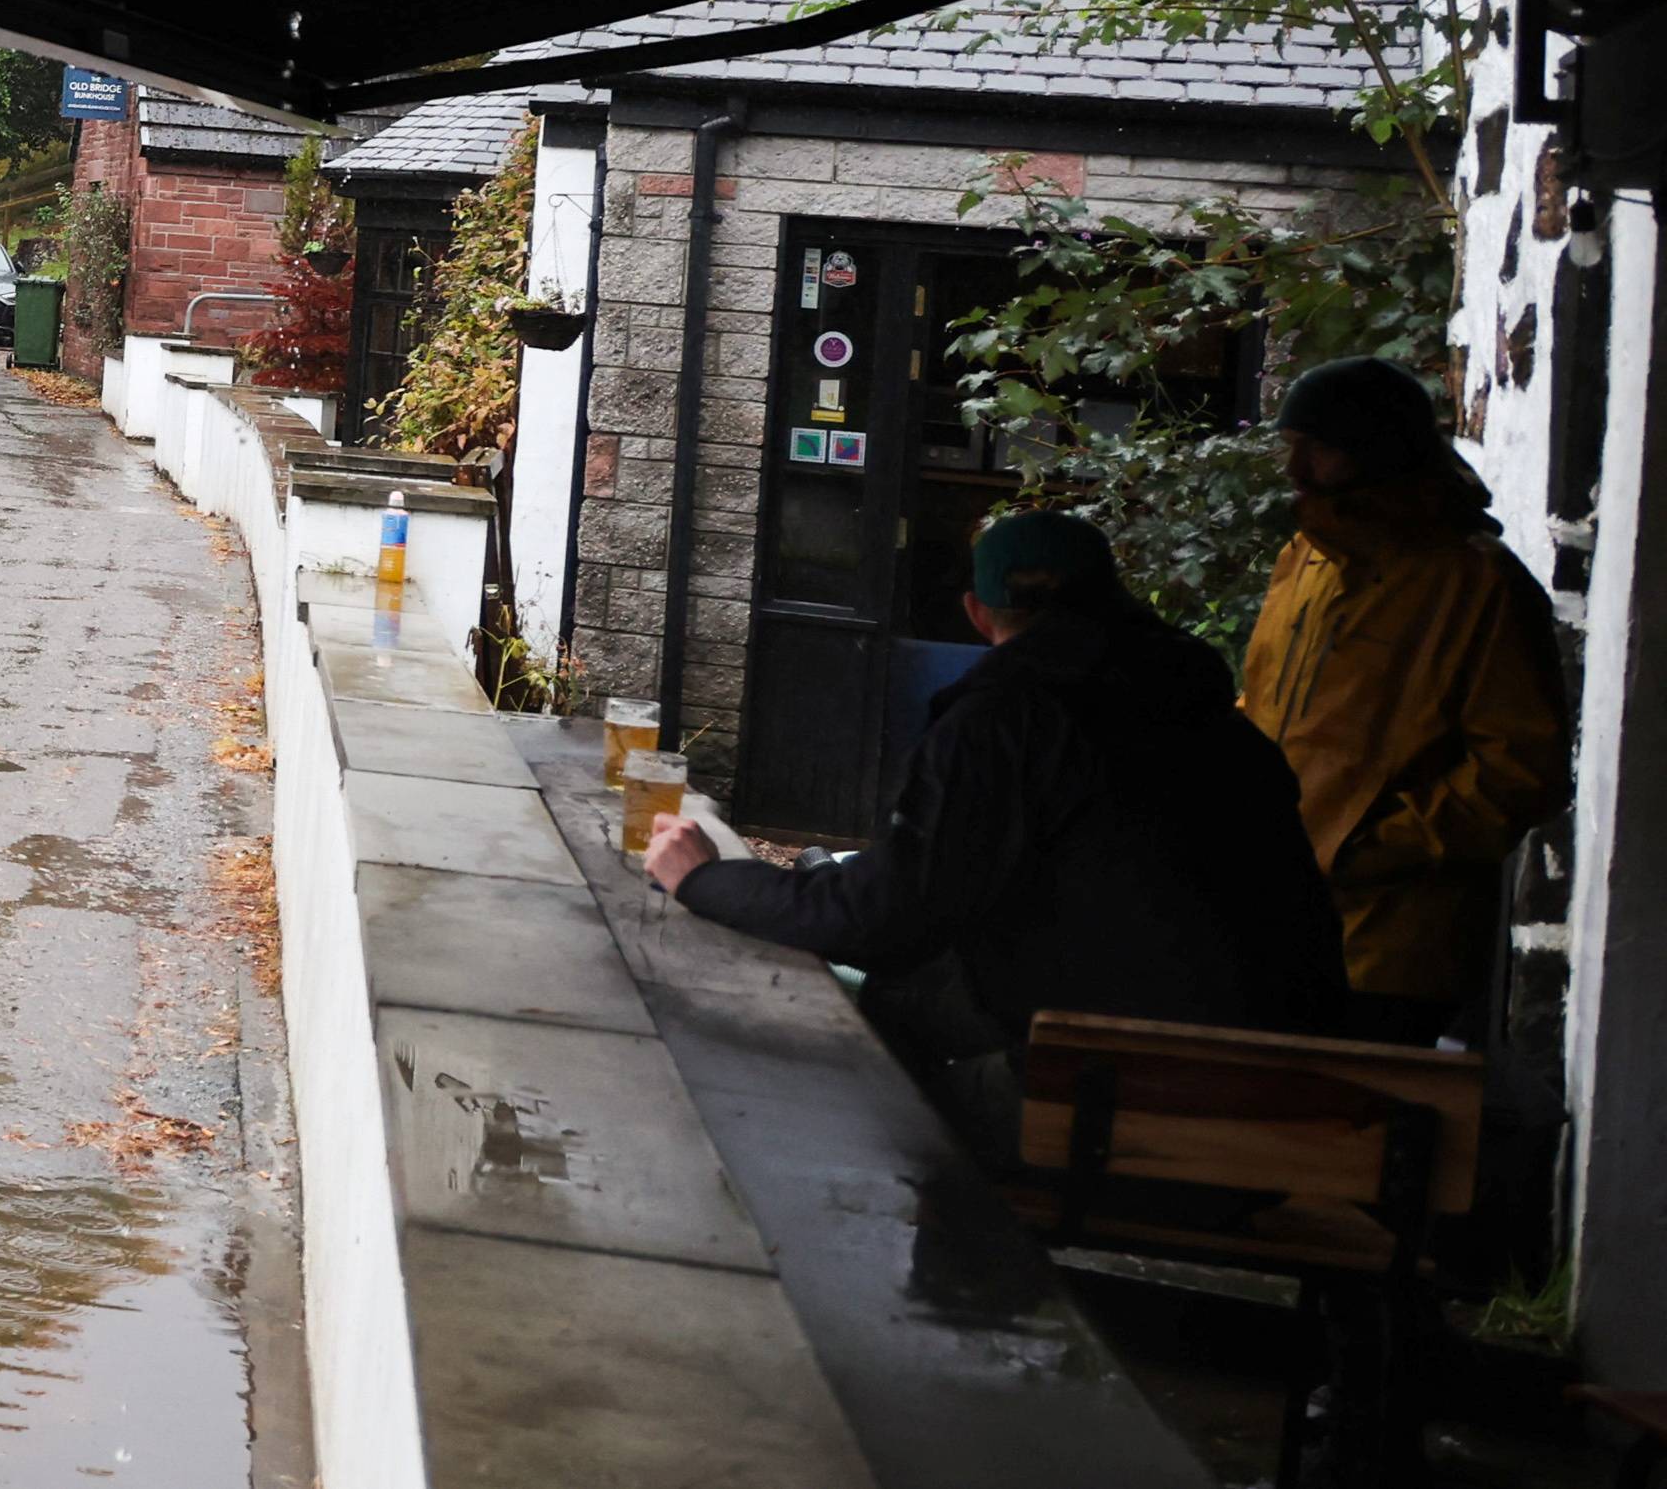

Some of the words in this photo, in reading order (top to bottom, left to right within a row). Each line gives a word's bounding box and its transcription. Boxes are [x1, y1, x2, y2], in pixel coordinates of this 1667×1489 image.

[69, 81, 88, 91] OLD
[89, 83, 122, 94] BRIDGE
[74, 91, 115, 101] BUNKHOUSE
